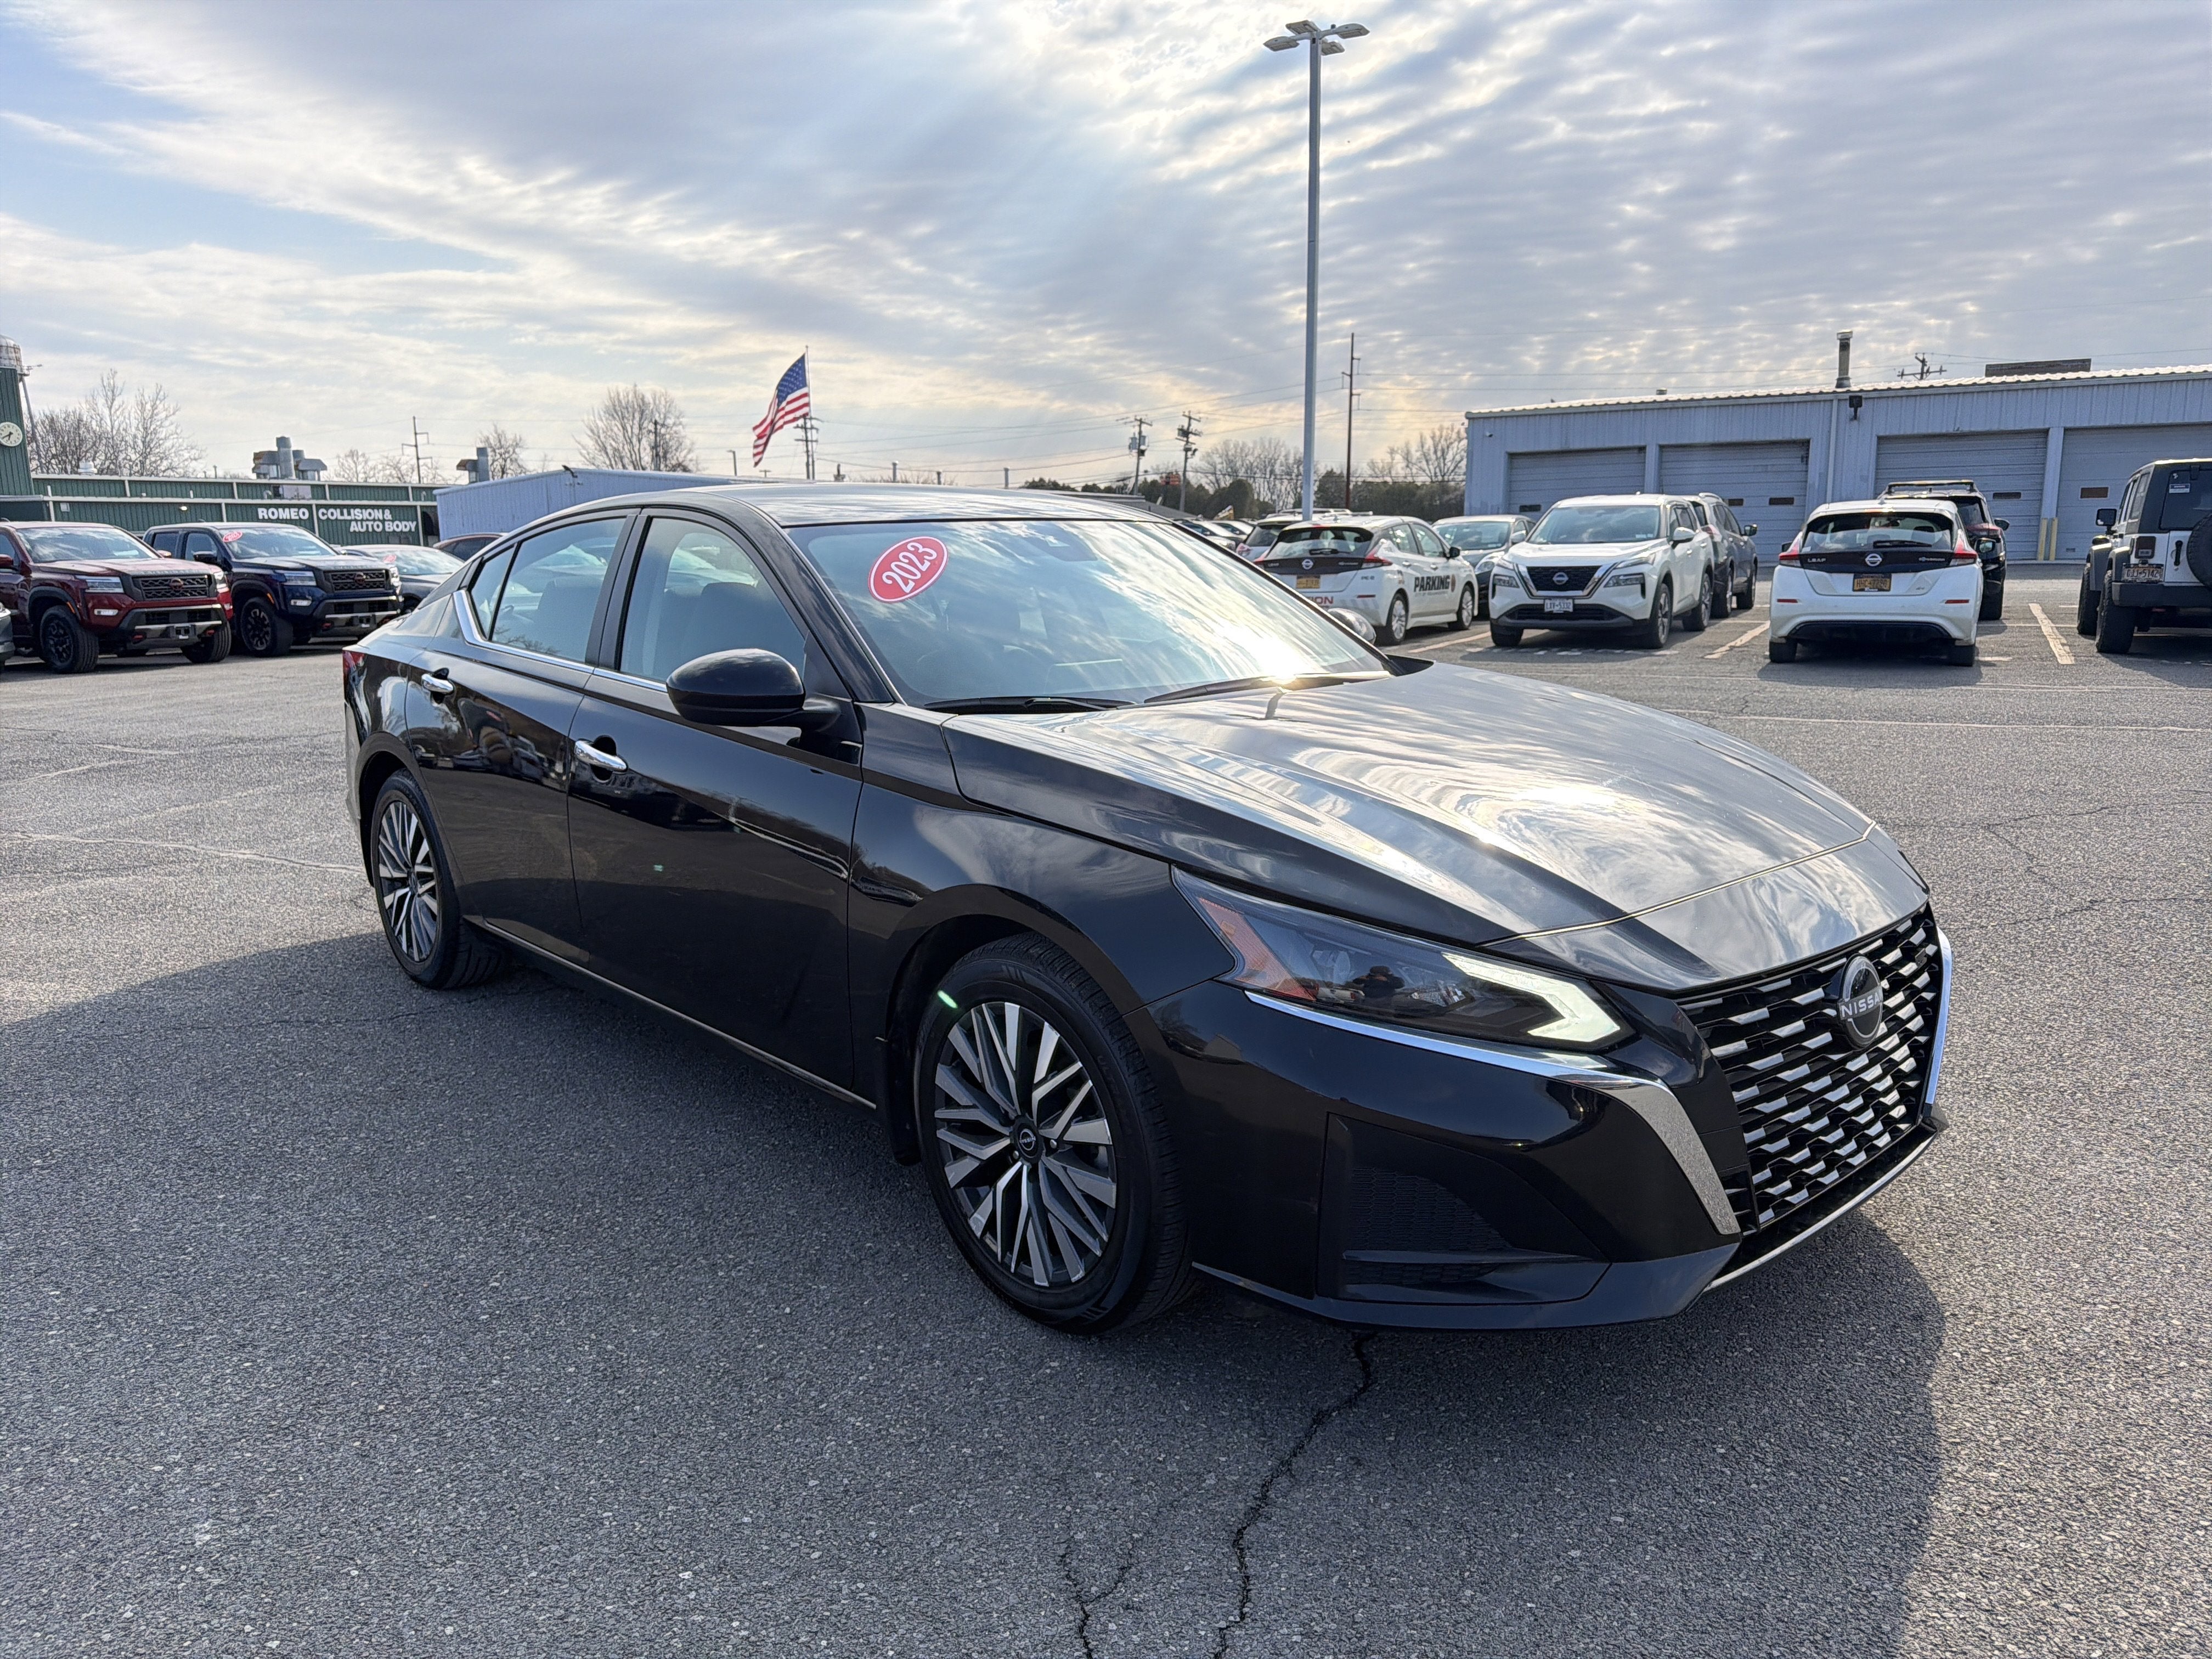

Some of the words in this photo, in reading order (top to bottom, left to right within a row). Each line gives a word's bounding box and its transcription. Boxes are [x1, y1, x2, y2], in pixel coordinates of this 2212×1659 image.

[257, 507, 309, 520] ROMEO
[318, 508, 383, 520] COLLISION
[383, 509, 392, 521] &
[349, 521, 382, 532] AUTO
[385, 521, 417, 532] BODY
[882, 542, 937, 593] 2023
[1413, 575, 1450, 592] PARKING
[1841, 992, 1882, 1017] NISSA
[1019, 1136, 1036, 1144] NISSA
